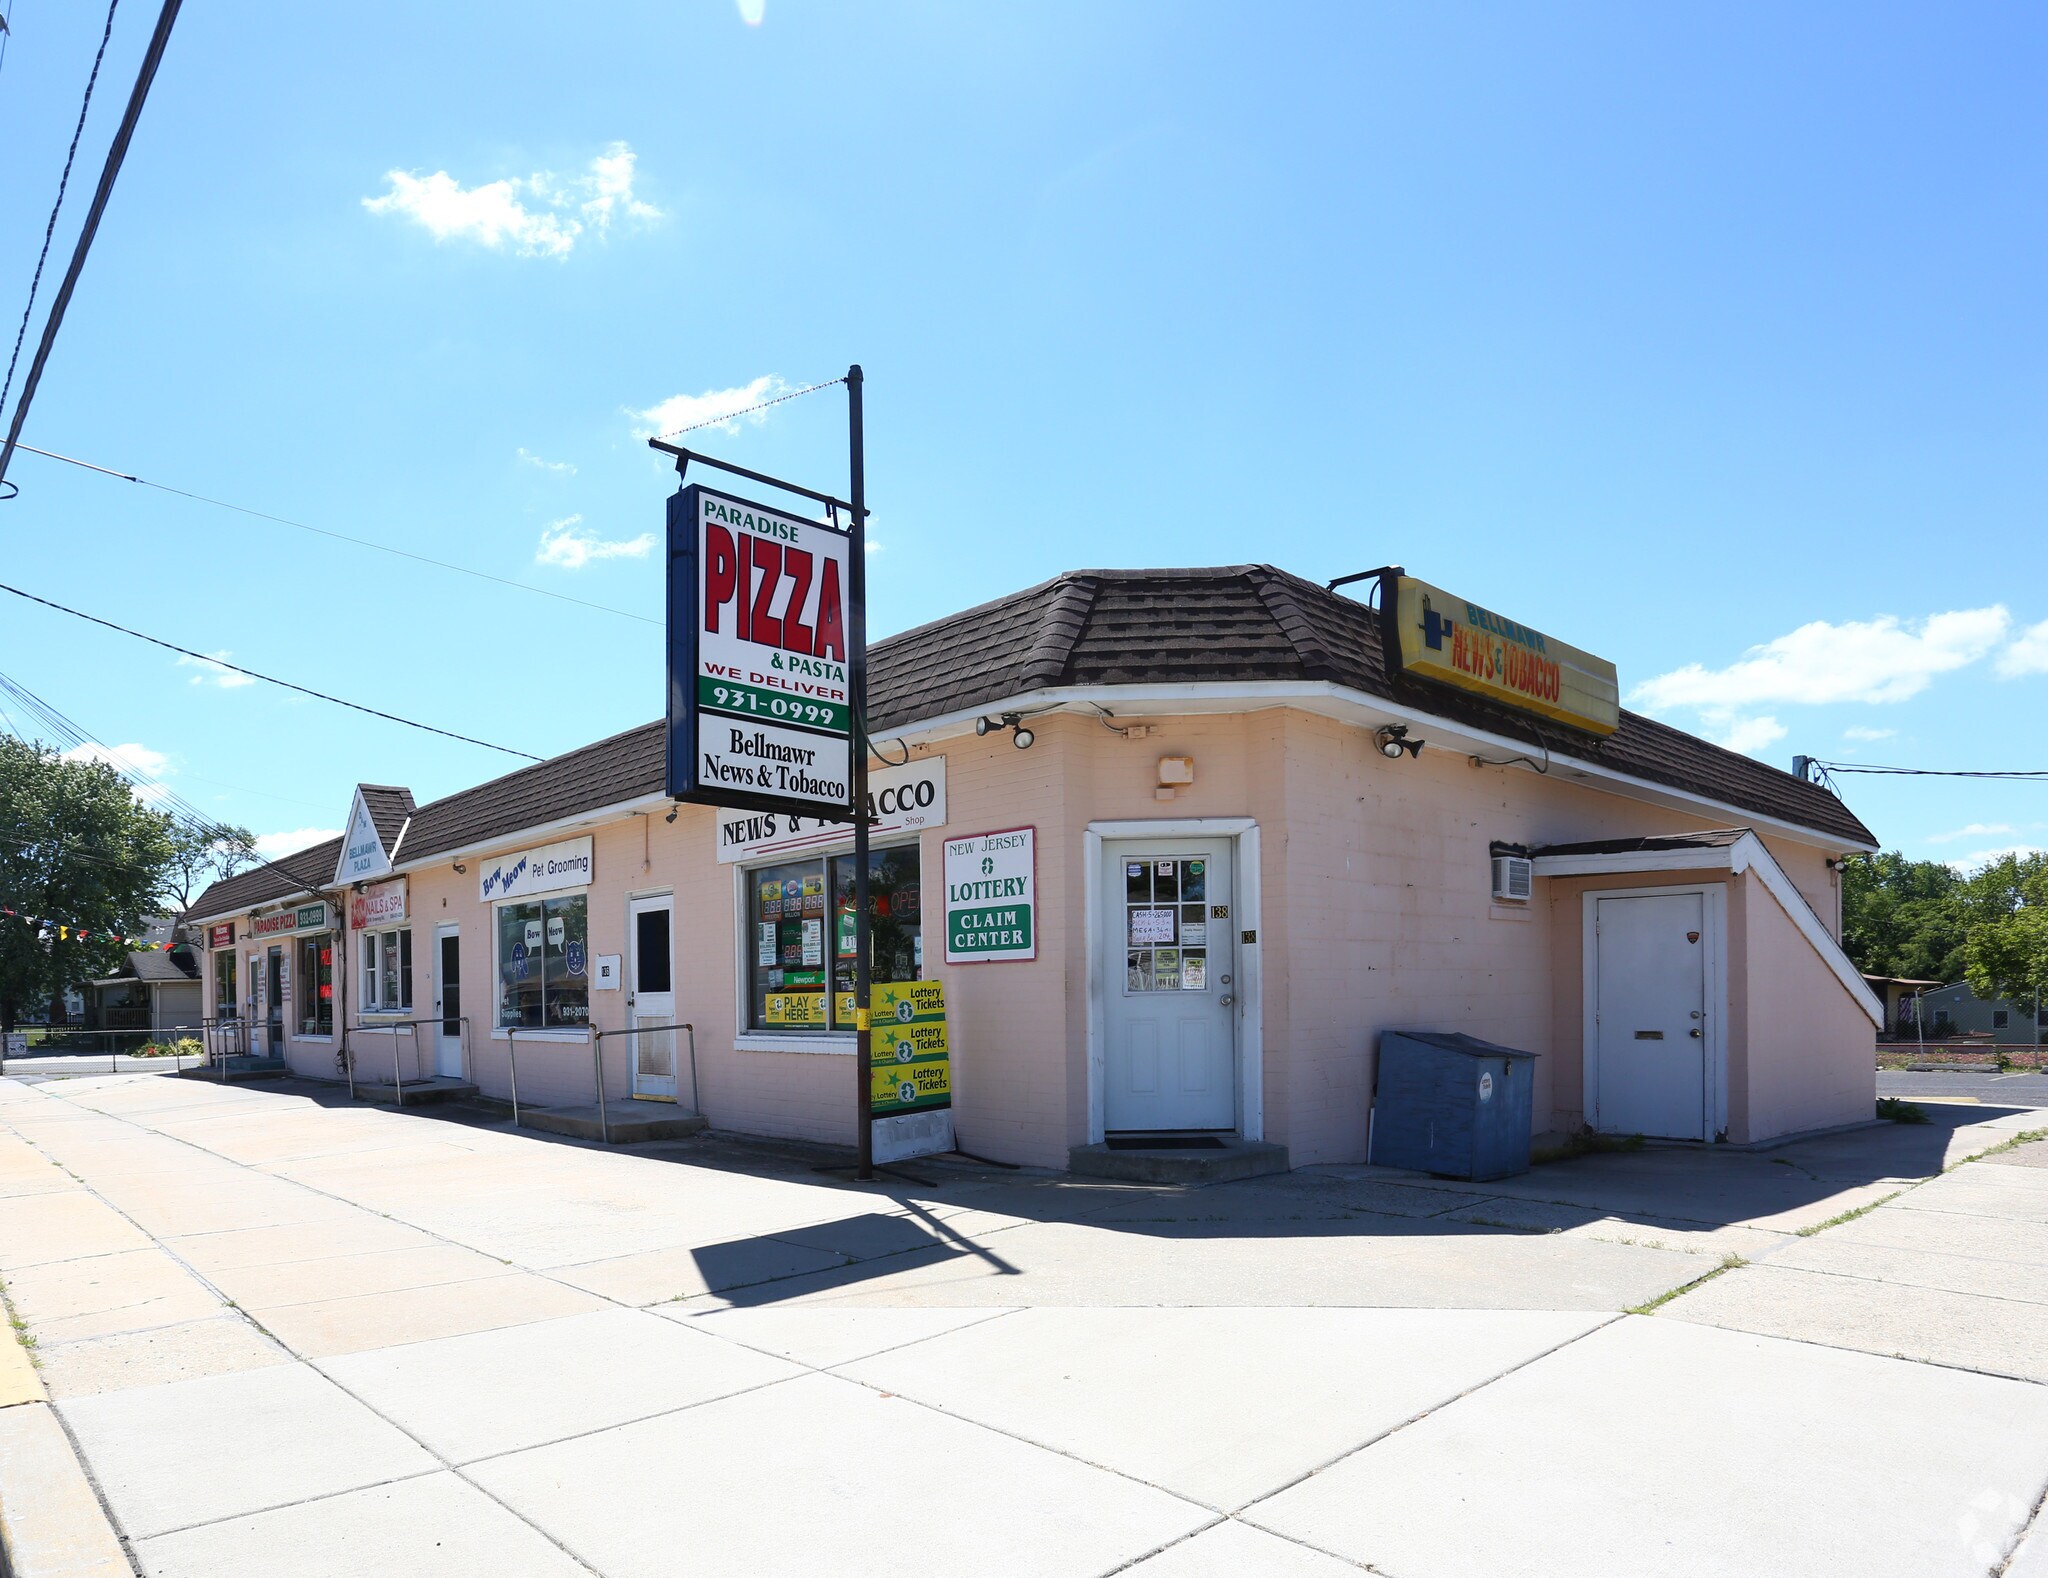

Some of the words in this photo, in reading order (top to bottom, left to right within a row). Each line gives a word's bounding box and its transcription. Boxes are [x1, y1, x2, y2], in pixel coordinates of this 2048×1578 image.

[704, 500, 798, 544] PARADISE
[705, 522, 846, 663] PIZZA
[1466, 604, 1545, 654] BELLMAWR
[771, 652, 783, 670] &
[789, 656, 844, 683] PASTA
[1452, 622, 1494, 680] NEWS
[1502, 641, 1559, 702] TOBACCO
[704, 662, 742, 680] WE
[750, 673, 844, 700] DELIVER
[713, 687, 834, 724] 931-0999
[729, 728, 815, 766] Bellmawr
[704, 754, 753, 787] News
[757, 767, 772, 788] &
[776, 766, 845, 799] Tobacco
[723, 814, 776, 846] NEWS
[905, 817, 924, 826] Shop
[350, 841, 376, 859] BELLMAWR
[949, 842, 974, 856] NEW
[982, 834, 1027, 852] JERSEY
[354, 858, 370, 872] PLAZA
[533, 864, 544, 877] Pet
[548, 855, 588, 874] Grooming
[950, 876, 1027, 902] LOTTERY
[366, 899, 383, 915] NAILS
[390, 895, 402, 910] SPA
[892, 890, 919, 910] OPE
[961, 911, 1016, 929] CLAIM
[1212, 906, 1228, 918] 138
[254, 917, 279, 934] PARADISE
[280, 913, 296, 930] PIZZA
[548, 926, 563, 936] Meow
[527, 930, 541, 939] Bow
[955, 930, 1023, 948] CENTER
[1243, 932, 1255, 944] 138
[784, 996, 809, 1008] PLAY
[911, 988, 940, 999] Lottery
[563, 1007, 588, 1016] 931-2070
[916, 998, 944, 1010] Tickets
[501, 1009, 521, 1020] Supplies
[785, 1008, 808, 1020] HERE
[911, 1028, 941, 1038] Lottery
[916, 1038, 944, 1050] Tickets
[913, 1068, 944, 1079] Lottery
[919, 1079, 947, 1091] Tickets
